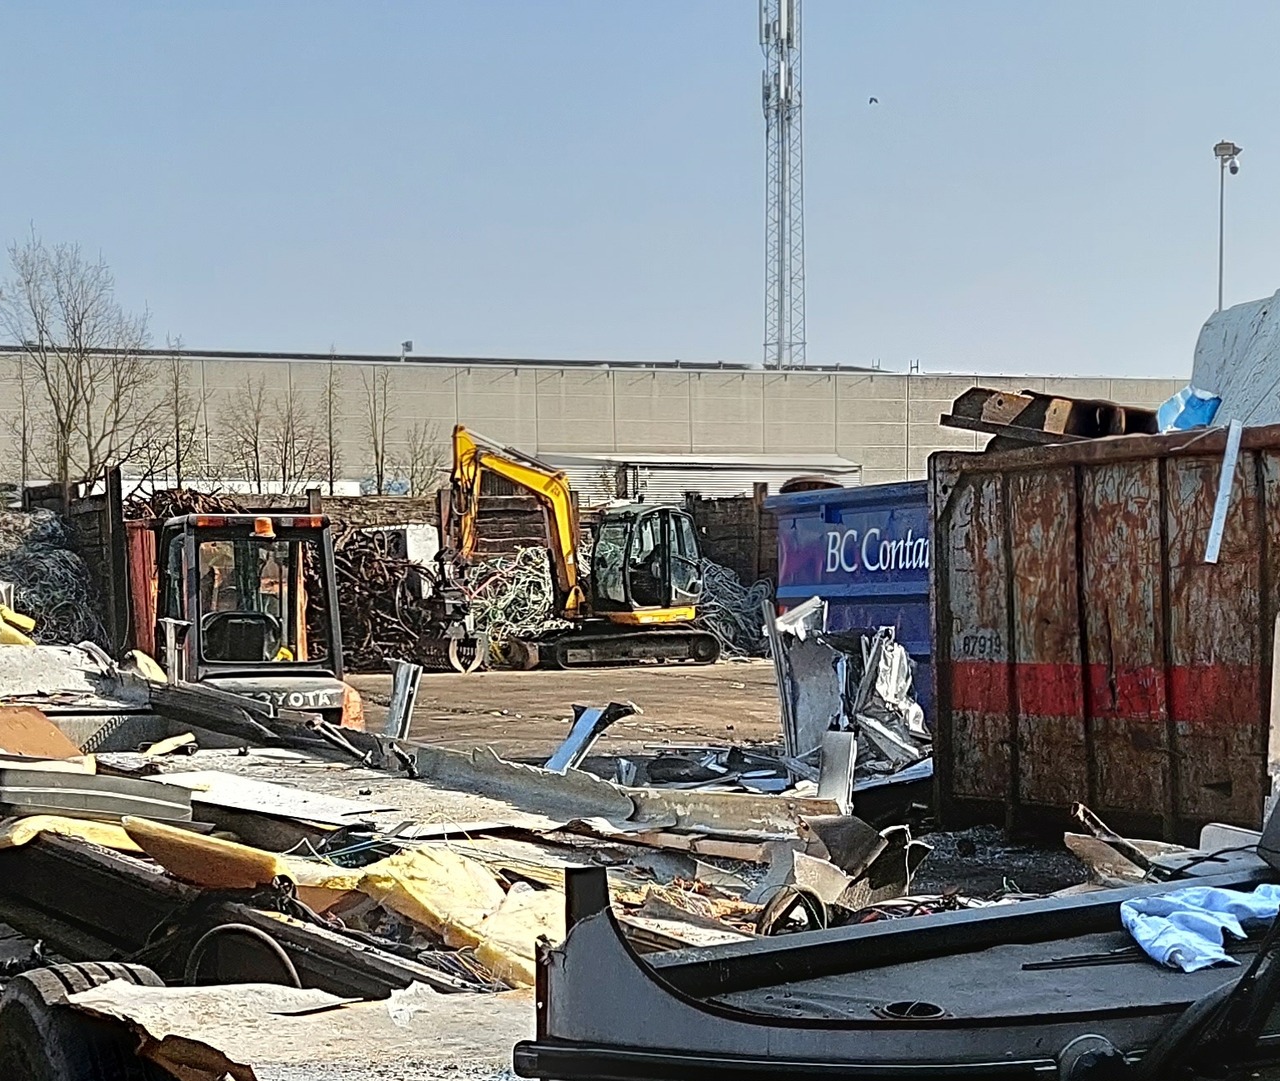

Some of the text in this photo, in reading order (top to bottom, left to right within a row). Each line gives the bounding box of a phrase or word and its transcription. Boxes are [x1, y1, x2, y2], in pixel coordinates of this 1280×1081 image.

[825, 529, 859, 573] BC
[963, 635, 1001, 656] 87919
[239, 690, 332, 708] YOTA
